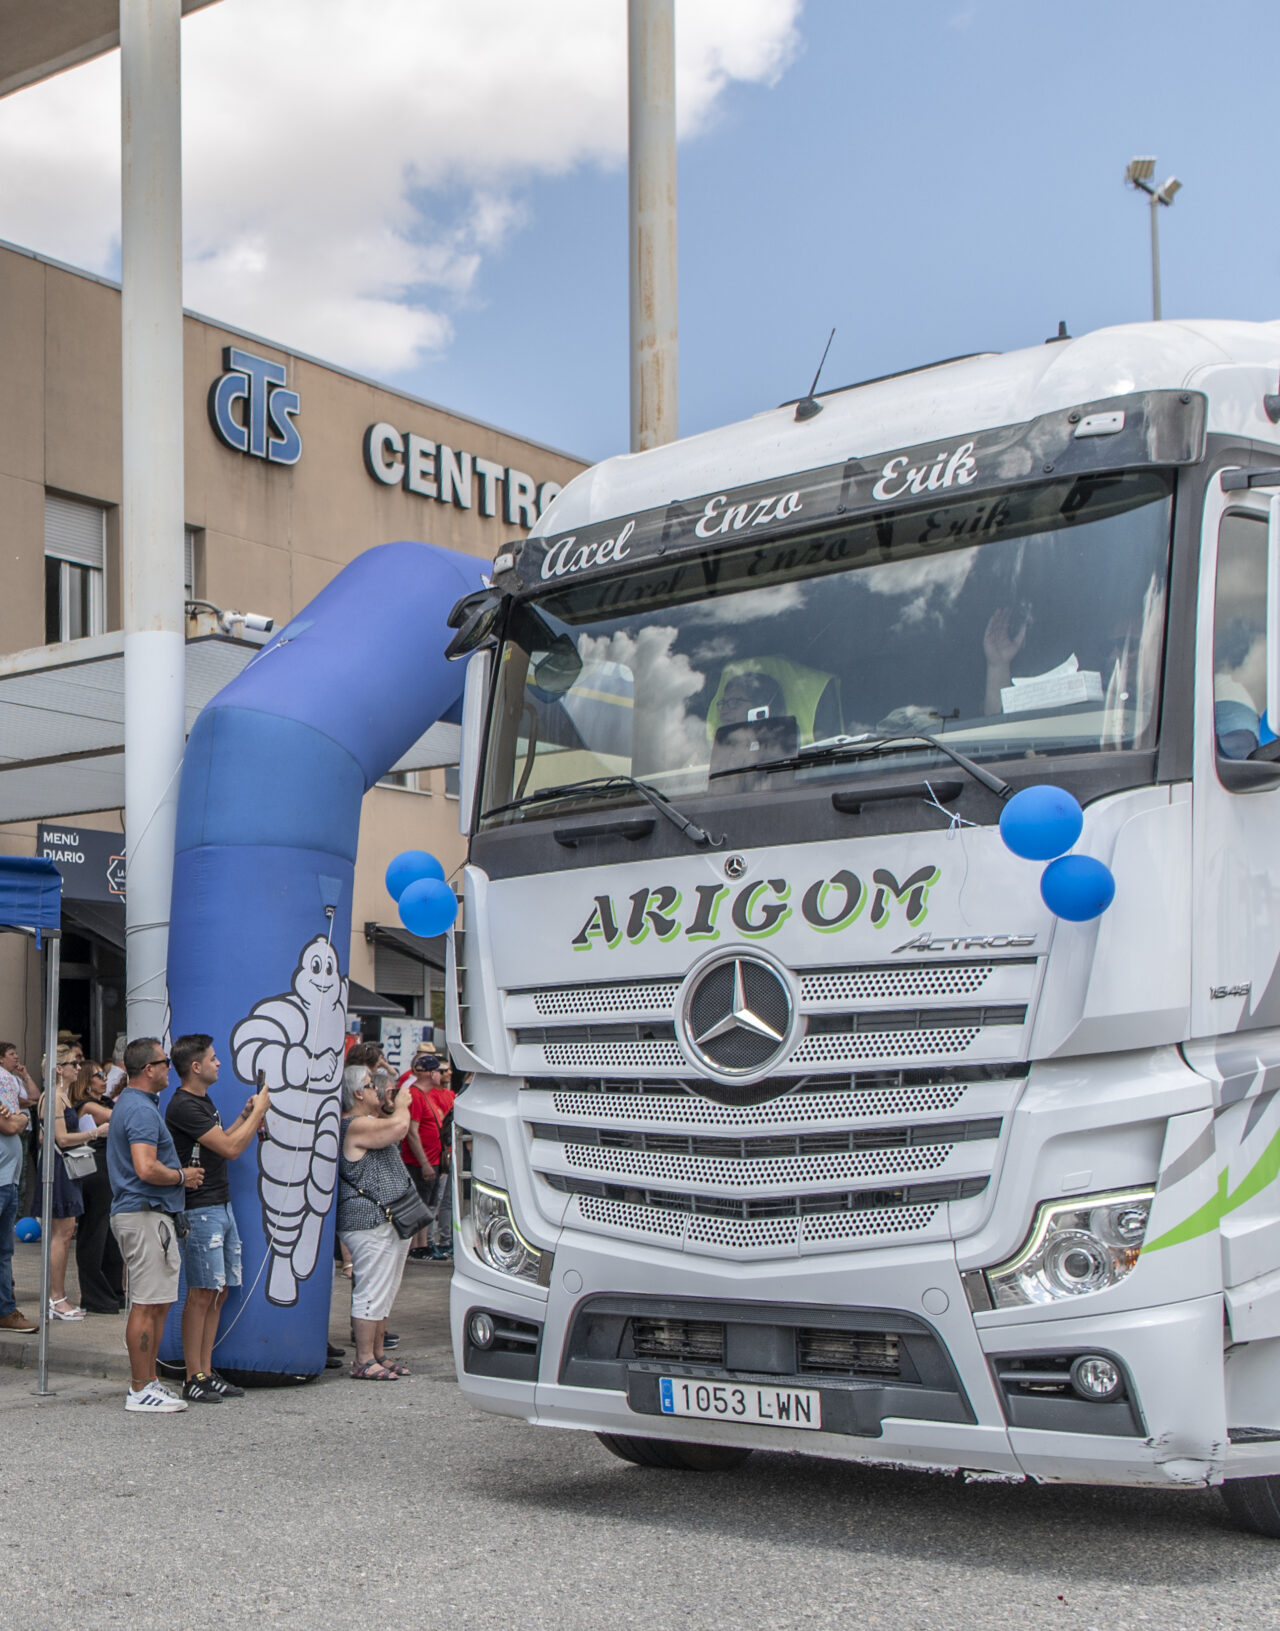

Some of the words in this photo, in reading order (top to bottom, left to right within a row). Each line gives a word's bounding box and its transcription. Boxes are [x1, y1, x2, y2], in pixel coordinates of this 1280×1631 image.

[210, 346, 302, 466] CTS
[541, 520, 635, 580] Axel
[694, 489, 803, 539] Enzo
[872, 441, 978, 500] Erik
[43, 831, 80, 846] MENÚ
[43, 849, 85, 864] DIARIO
[571, 865, 942, 951] ARIGOM
[682, 1384, 746, 1415] 1053
[757, 1391, 811, 1422] LWN
